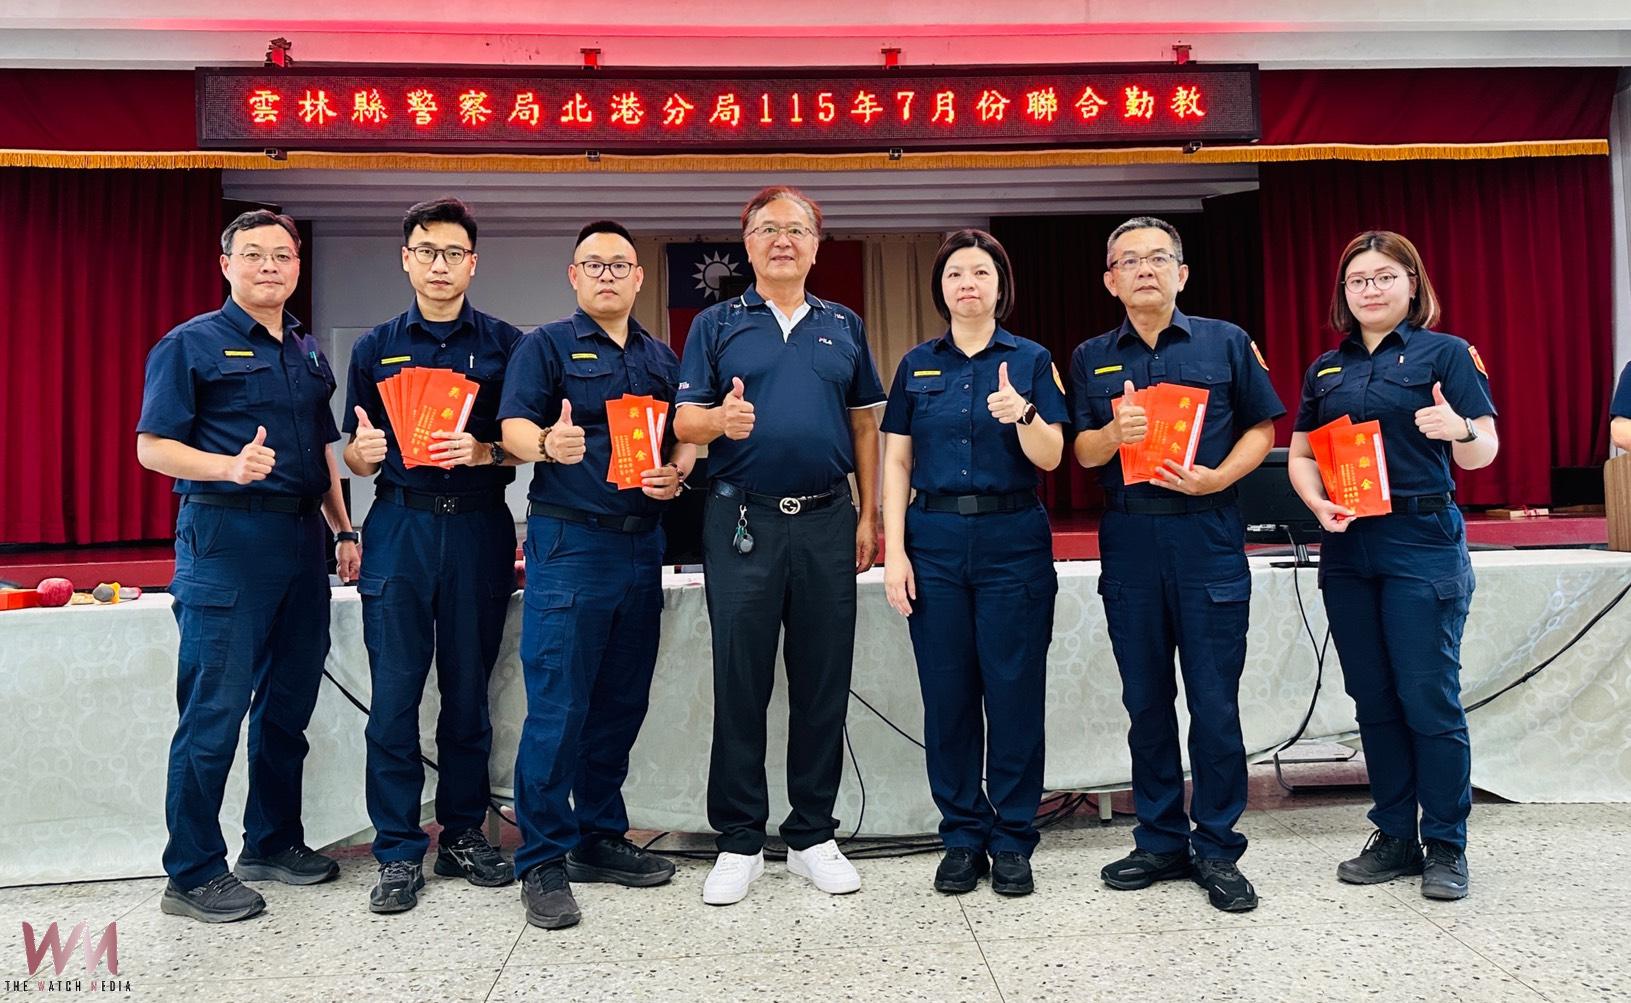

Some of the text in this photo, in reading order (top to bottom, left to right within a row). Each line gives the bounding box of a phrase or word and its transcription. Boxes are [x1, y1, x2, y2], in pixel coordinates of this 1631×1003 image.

[248, 85, 1205, 126] 雲林縣警察局北港分局115年7月份聯合勤教
